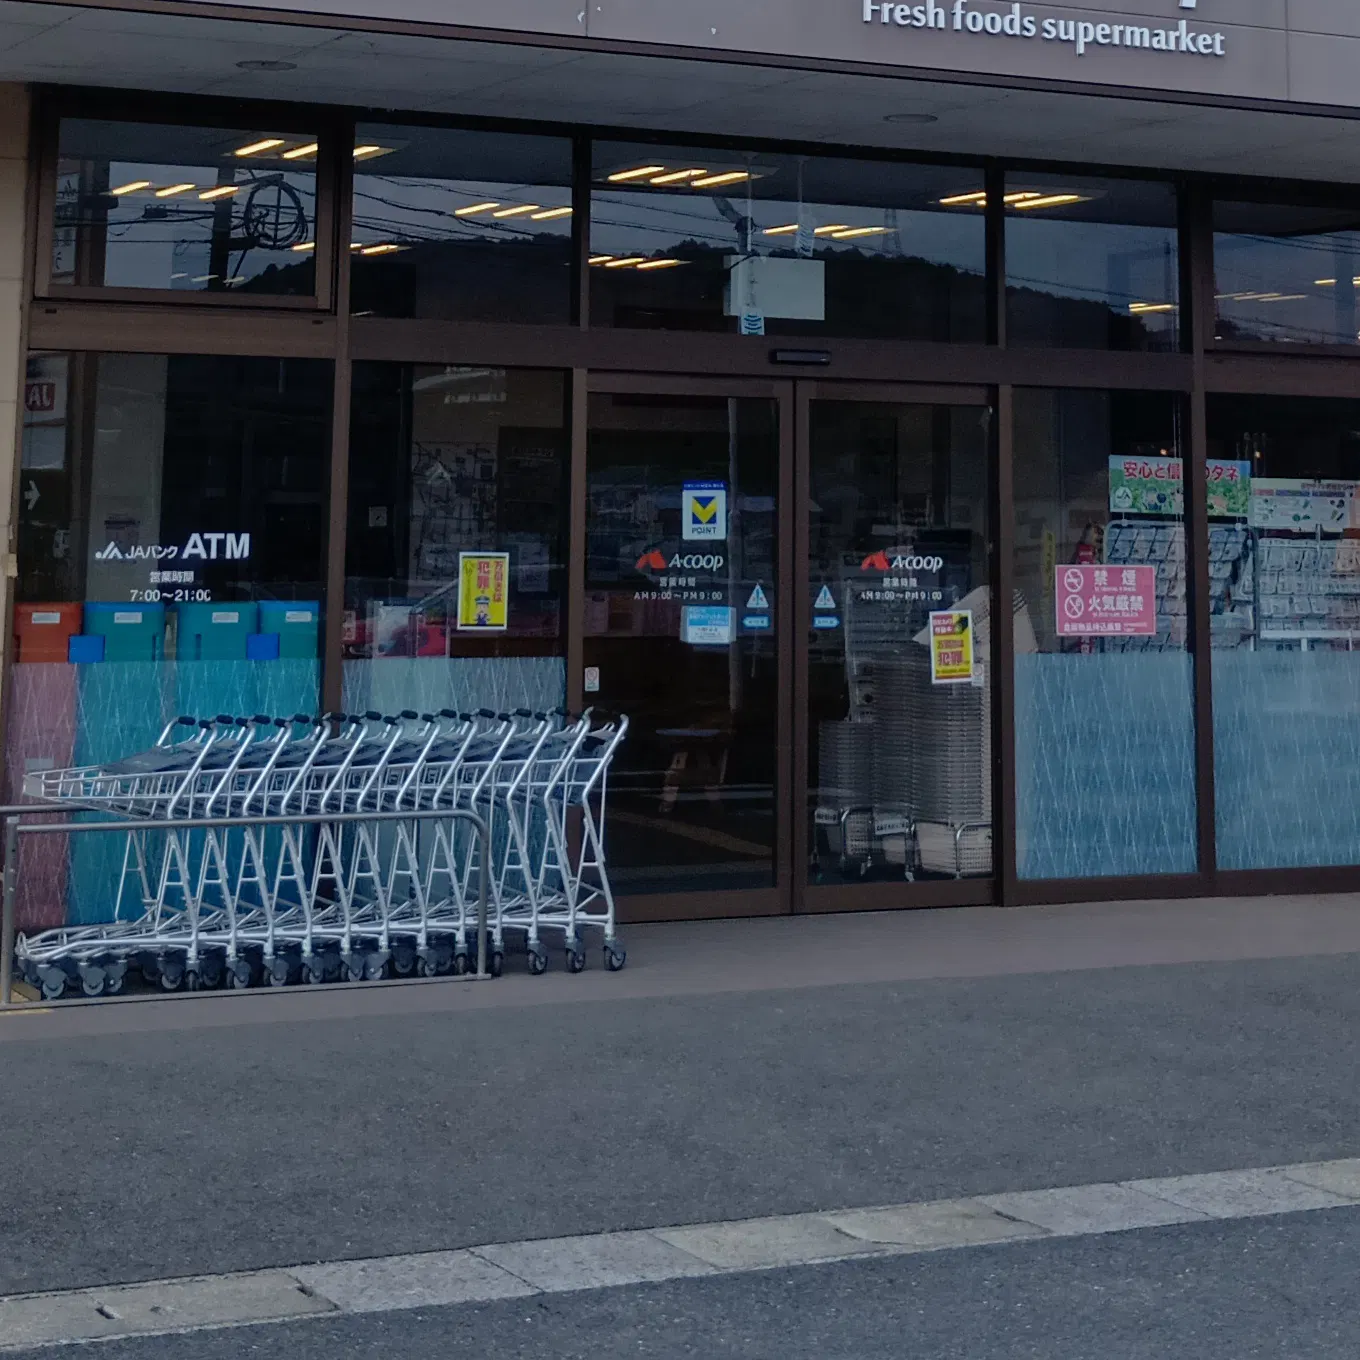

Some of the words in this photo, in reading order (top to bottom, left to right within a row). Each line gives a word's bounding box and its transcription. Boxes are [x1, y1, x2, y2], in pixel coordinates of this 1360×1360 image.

[1041, 18, 1226, 56] supermarket
[691, 527, 717, 535] POINT
[125, 545, 179, 559] JAバンク
[181, 533, 251, 559] ATM
[149, 571, 195, 583] 営業時間
[659, 576, 696, 587] 営業時間
[883, 577, 918, 588] 営業時間
[1088, 594, 1144, 612] 火気厳禁
